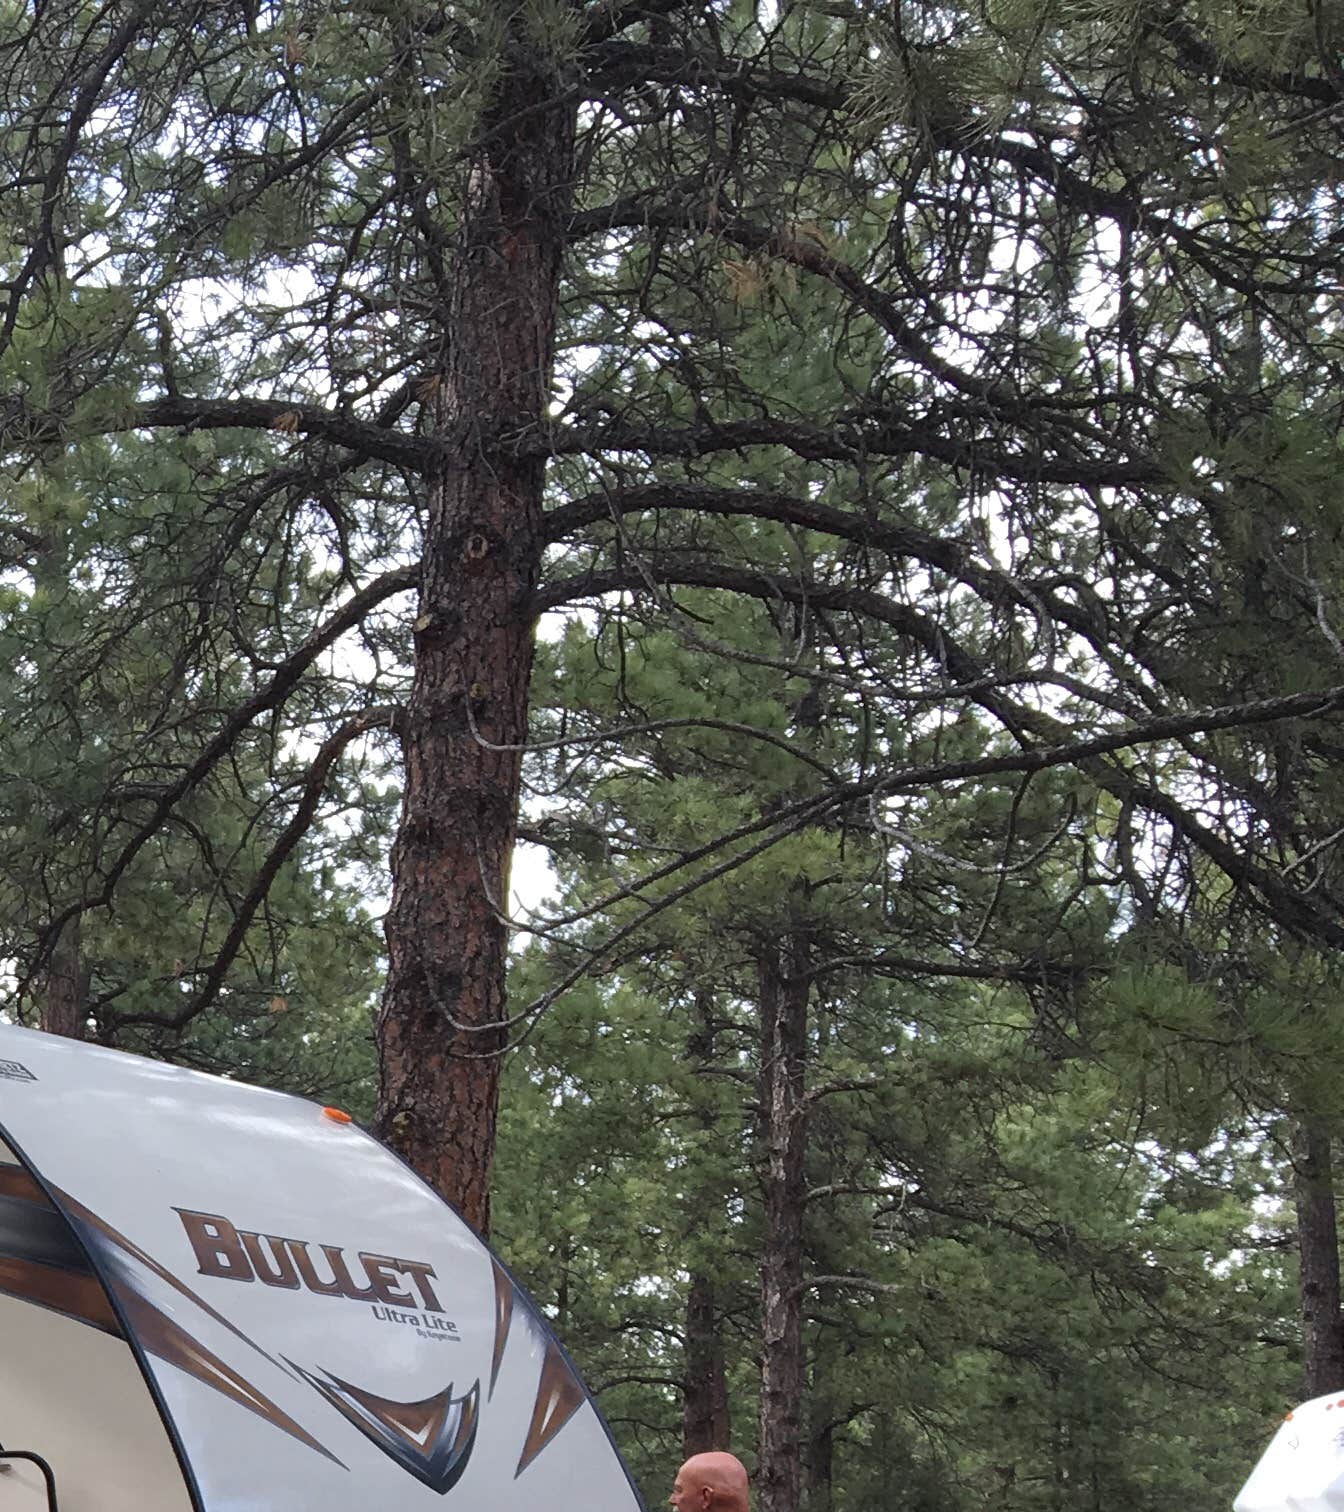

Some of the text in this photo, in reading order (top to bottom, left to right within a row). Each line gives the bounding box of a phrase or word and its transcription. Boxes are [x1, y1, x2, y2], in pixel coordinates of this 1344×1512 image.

[170, 1206, 446, 1313] BULLET
[371, 1305, 458, 1333] Ultra Lite
